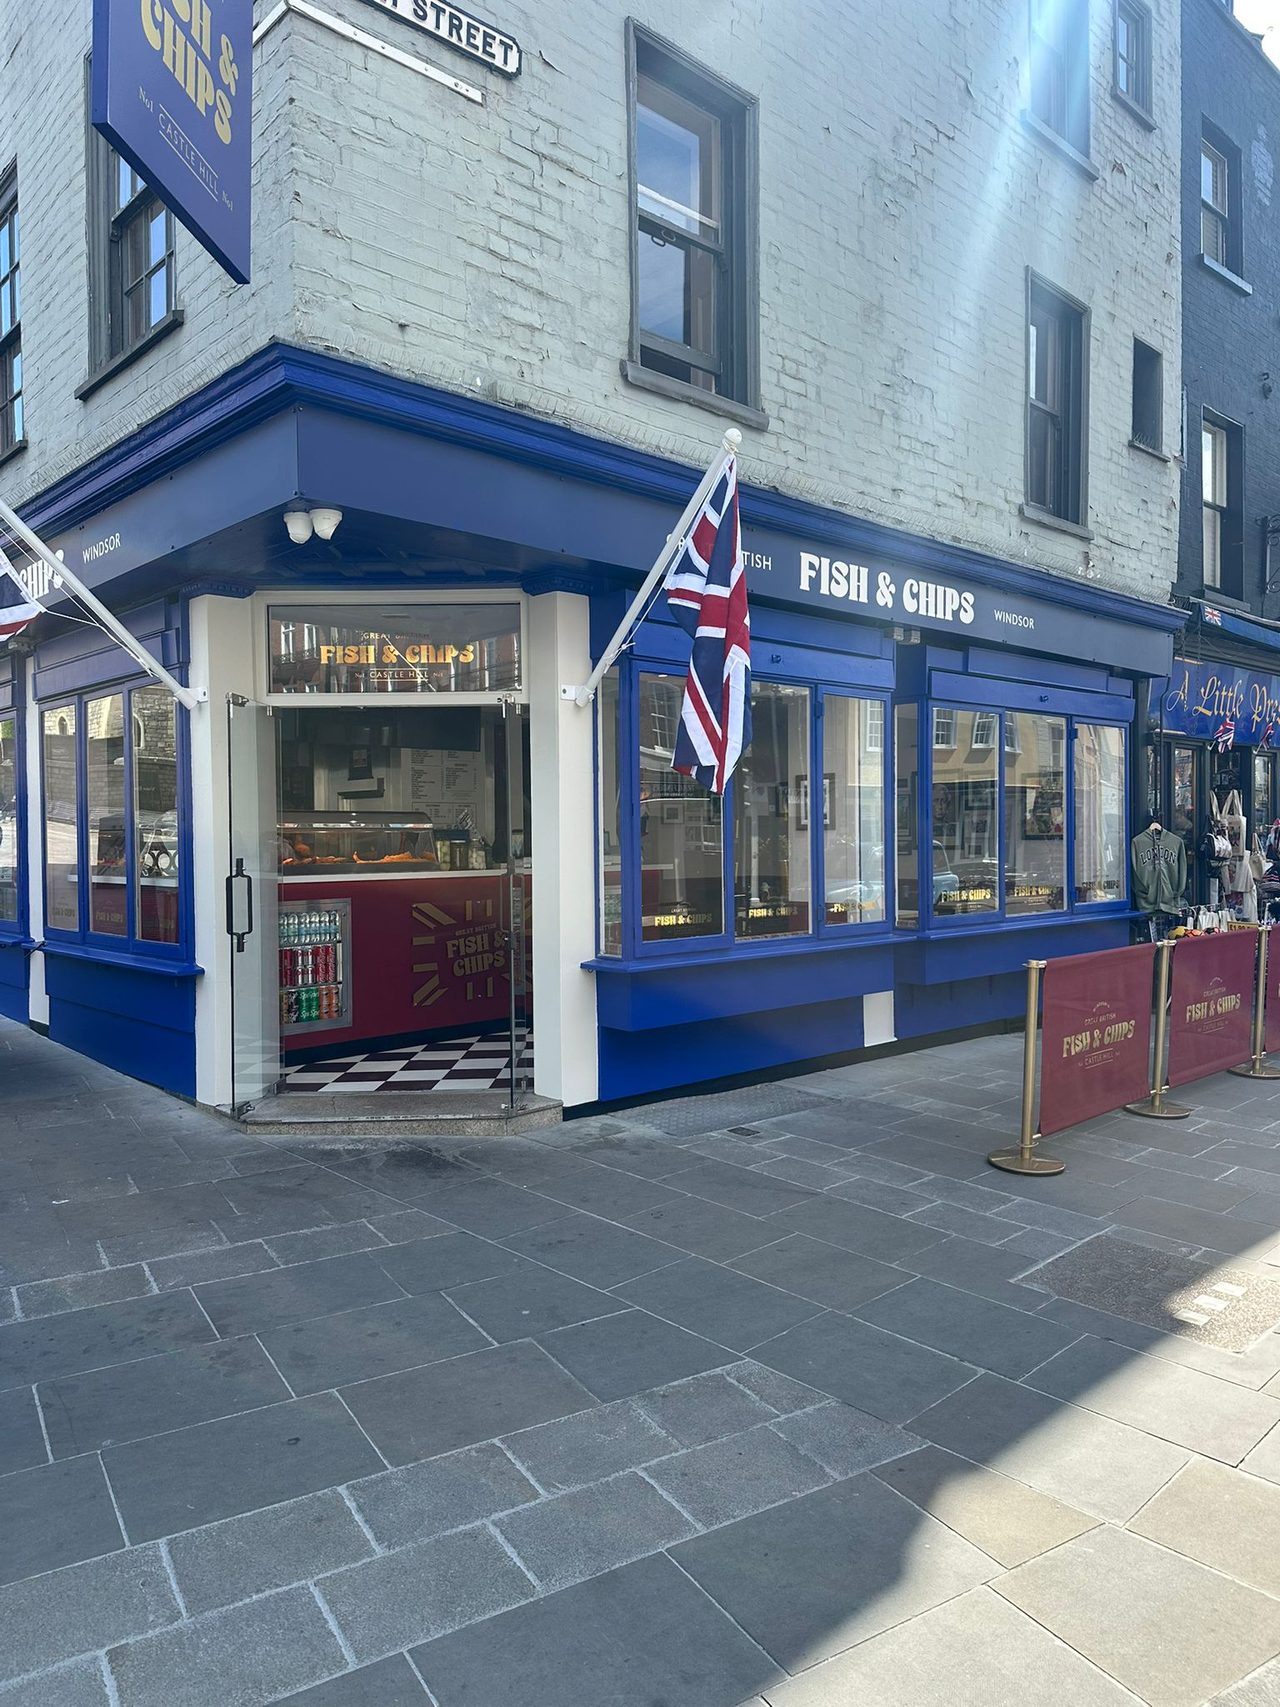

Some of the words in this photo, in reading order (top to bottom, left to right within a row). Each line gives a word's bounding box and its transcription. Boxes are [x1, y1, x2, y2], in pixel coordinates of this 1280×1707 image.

[413, 0, 514, 67] STREET
[141, 0, 232, 145] CHIPS
[219, 34, 239, 97] &
[158, 113, 197, 166] CASTLE
[199, 166, 219, 195] HILL
[82, 532, 121, 564] WINDSOR
[742, 551, 772, 571] TISH
[799, 552, 868, 603] FISH
[875, 571, 896, 608] &
[902, 578, 975, 624] CHIPS
[993, 609, 1035, 630] WINDSOR
[320, 645, 376, 664] FISH
[382, 645, 400, 664] &
[1166, 670, 1189, 712] A
[1192, 676, 1244, 719] Little
[941, 890, 960, 903] FISH
[961, 890, 968, 901] &
[968, 888, 991, 900] CHIPS
[654, 915, 676, 926] FISH
[686, 913, 712, 924] CHIPS
[748, 909, 767, 918] FISH
[446, 933, 489, 959] FISH
[453, 950, 506, 976] CHIPS
[1186, 1002, 1208, 1023] FISH
[1217, 993, 1241, 1014] CHIPS
[1062, 1031, 1091, 1058] FISH
[1093, 1029, 1102, 1049] &
[1103, 1019, 1136, 1045] CHIPS
